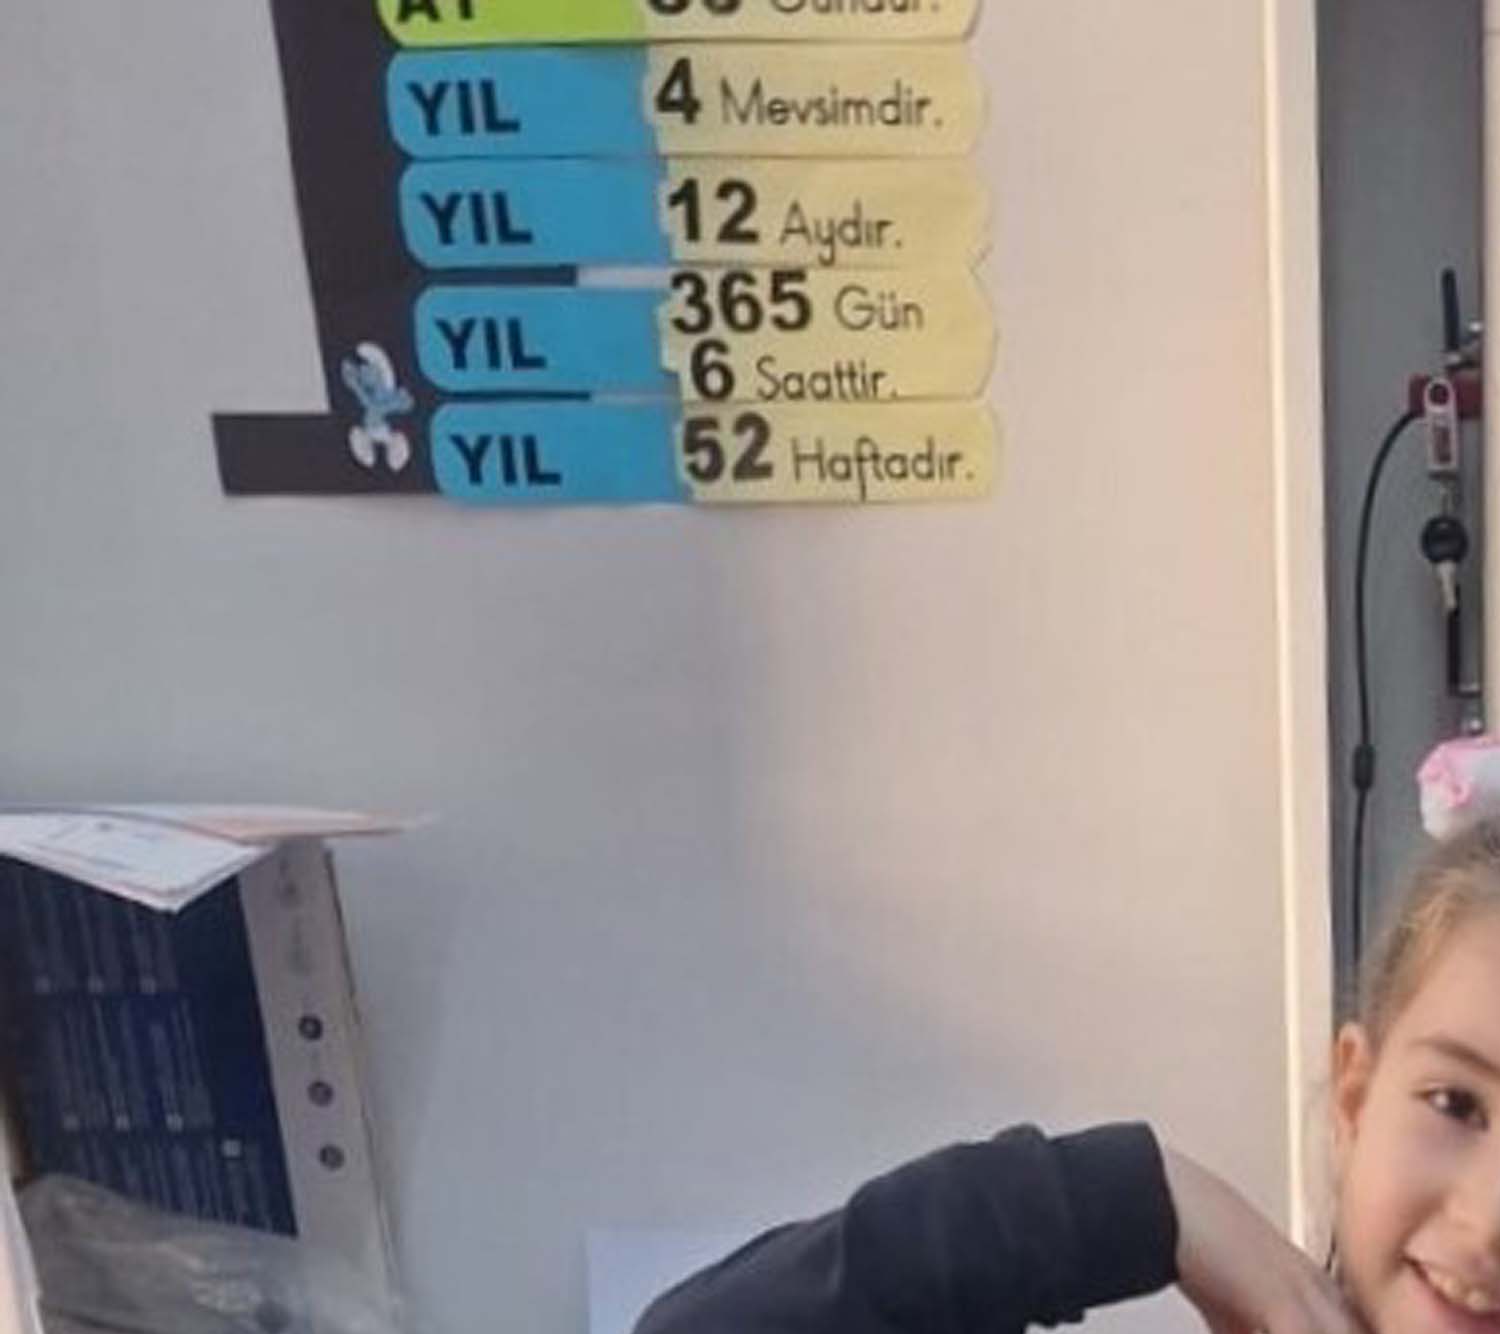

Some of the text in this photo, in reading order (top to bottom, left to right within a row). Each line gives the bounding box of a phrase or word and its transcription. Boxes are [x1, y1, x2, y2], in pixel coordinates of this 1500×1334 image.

[408, 59, 945, 134] YIL 4 Mevsimdir.
[420, 180, 904, 267] YIL 12 Aydır.
[434, 271, 925, 371] YIL 365 Gün
[690, 341, 899, 400] 6 Saattir.
[450, 415, 975, 502] YIL 52 Haftadır.
